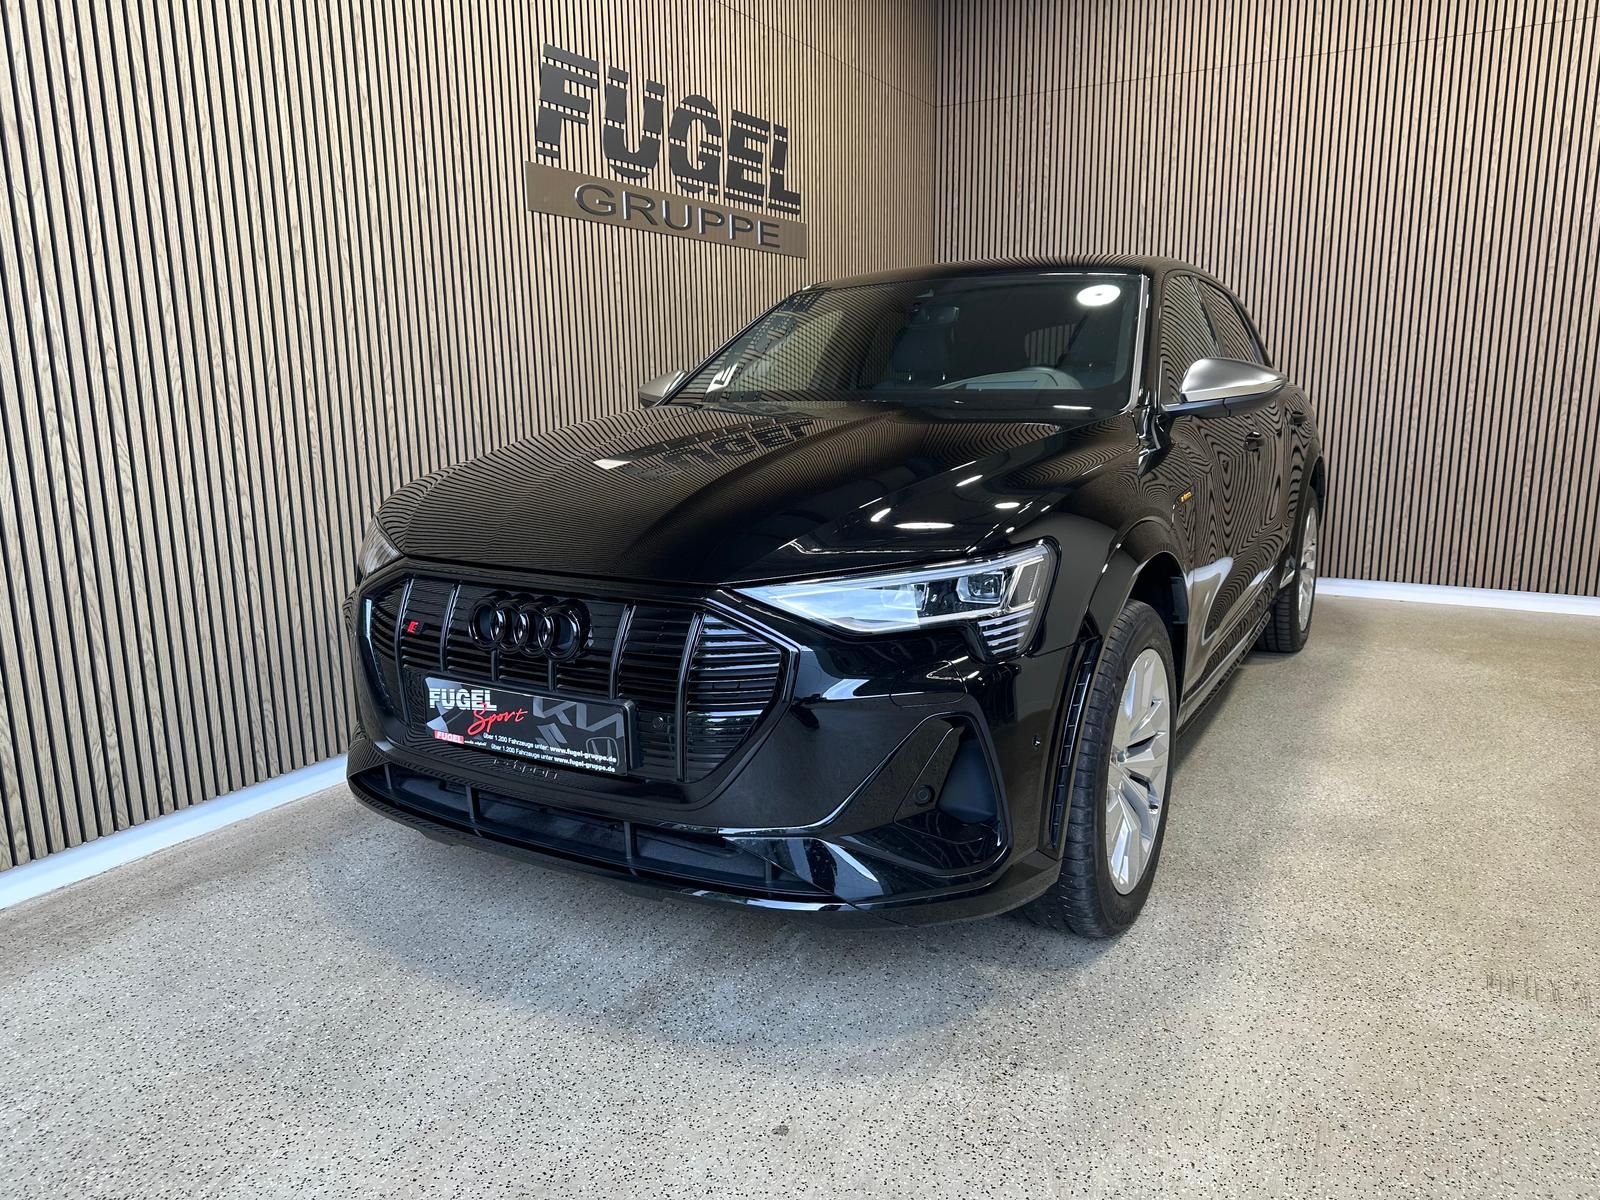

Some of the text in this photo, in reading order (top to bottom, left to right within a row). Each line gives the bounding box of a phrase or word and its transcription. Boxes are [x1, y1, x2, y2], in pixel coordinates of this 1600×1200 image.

[535, 42, 800, 216] FUGEL
[574, 183, 781, 248] GRUPPE
[429, 688, 497, 711] FUGEL
[467, 702, 528, 736] Sport
[549, 746, 617, 763] www.fugel-gruppe.de
[553, 757, 616, 773] www.fugel-gruppe.de
